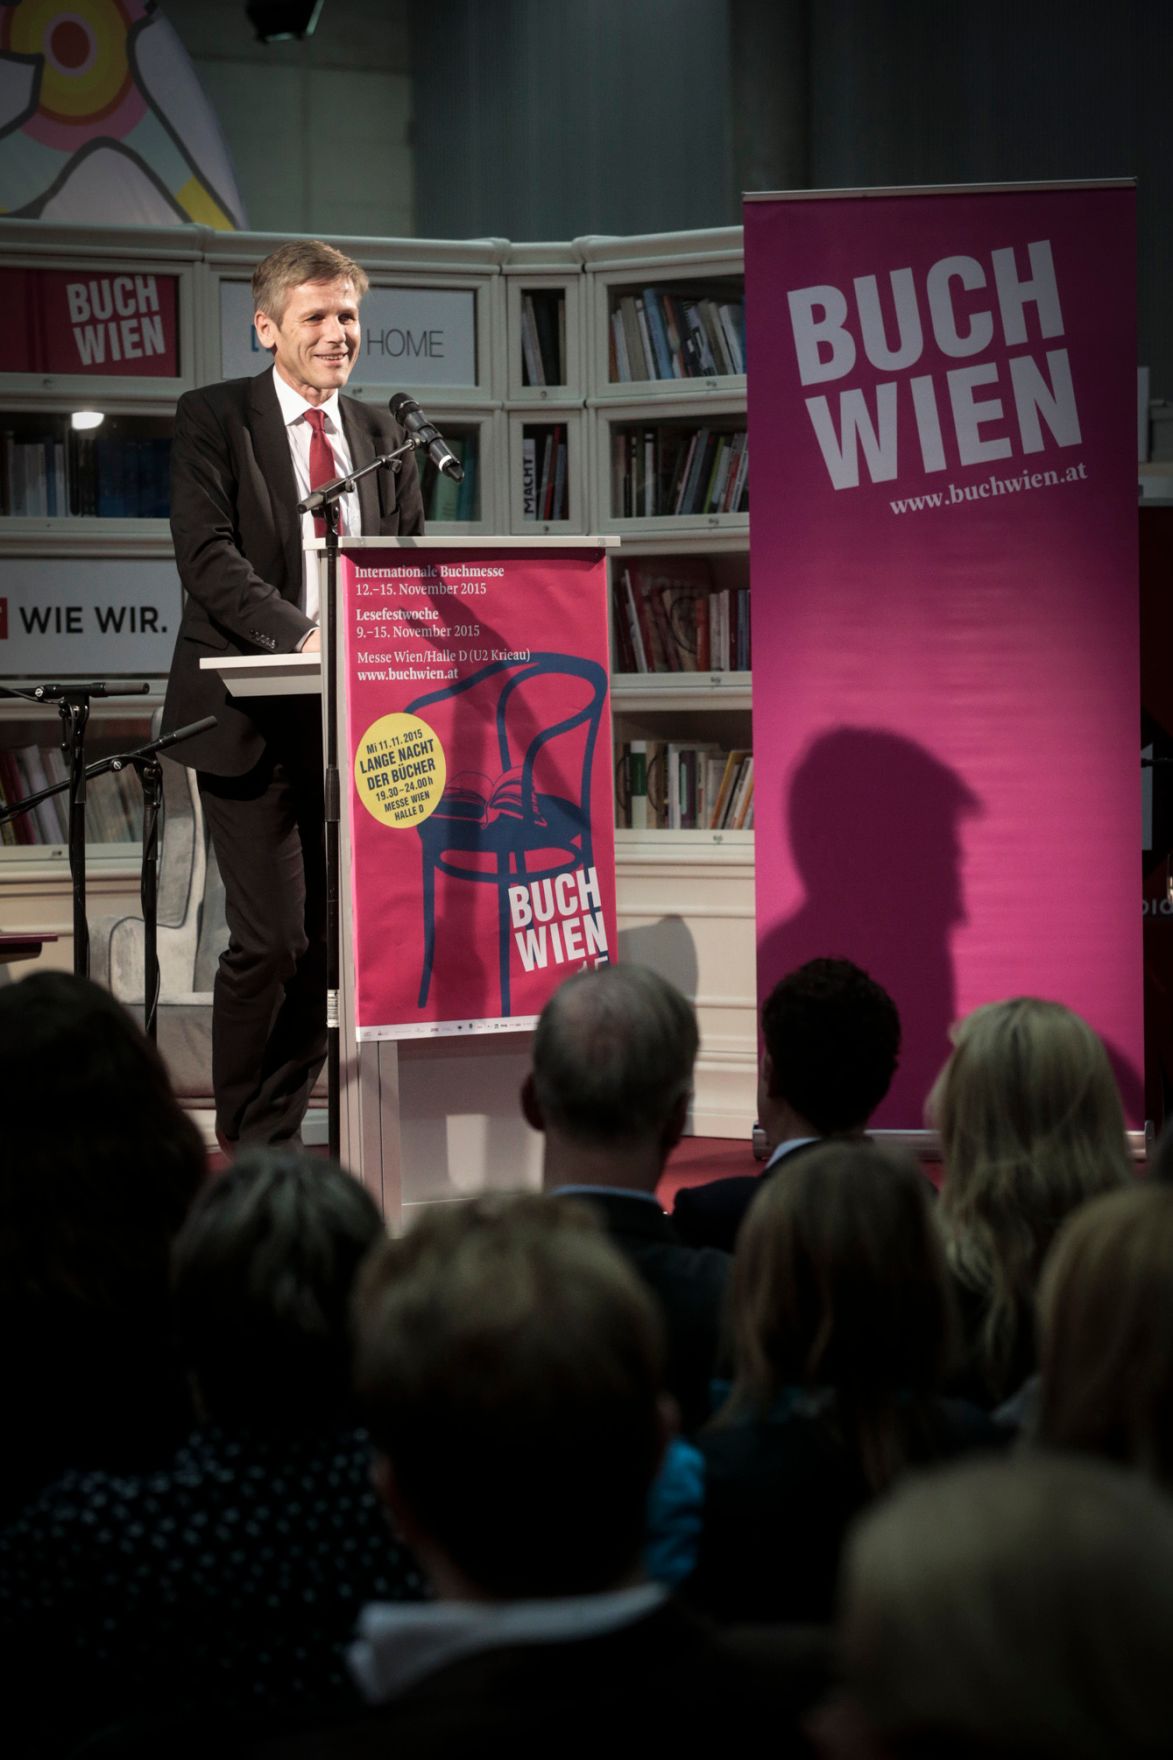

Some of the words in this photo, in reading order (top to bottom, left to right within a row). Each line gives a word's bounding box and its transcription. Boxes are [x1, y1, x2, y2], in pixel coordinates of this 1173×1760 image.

[65, 275, 161, 324] BUCH
[787, 239, 1065, 387] BUCH
[73, 315, 166, 366] WIEN
[366, 328, 444, 358] HOME
[804, 348, 1083, 491] WIEN
[523, 457, 535, 514] MACHT
[889, 462, 1089, 515] www.buchwien.at
[354, 566, 437, 578] Internationale
[439, 565, 505, 577] Buchmesse
[399, 583, 458, 595] November
[460, 582, 487, 595] 2015
[19, 606, 83, 634] WIE
[94, 606, 168, 634] WIR.
[355, 607, 439, 621] Lesefestwoche
[393, 626, 452, 638] November
[454, 625, 480, 637] 2015
[357, 652, 392, 664] Messe
[394, 650, 457, 664] Wien/Halle
[459, 650, 467, 661] D
[469, 649, 489, 664] (U2
[491, 648, 531, 663] Krieau)
[357, 667, 459, 681] www.buchwien.at
[360, 751, 396, 774] LANGE
[398, 739, 434, 762] NACHT
[366, 743, 378, 754] Mi
[367, 772, 390, 791] DER
[391, 758, 436, 783] BÜCHER
[384, 797, 409, 812] MESSE
[411, 791, 430, 803] WIEN
[394, 806, 417, 821] HALLE
[418, 804, 424, 813] D
[508, 866, 602, 929] BUCH
[515, 911, 609, 973] WIEN
